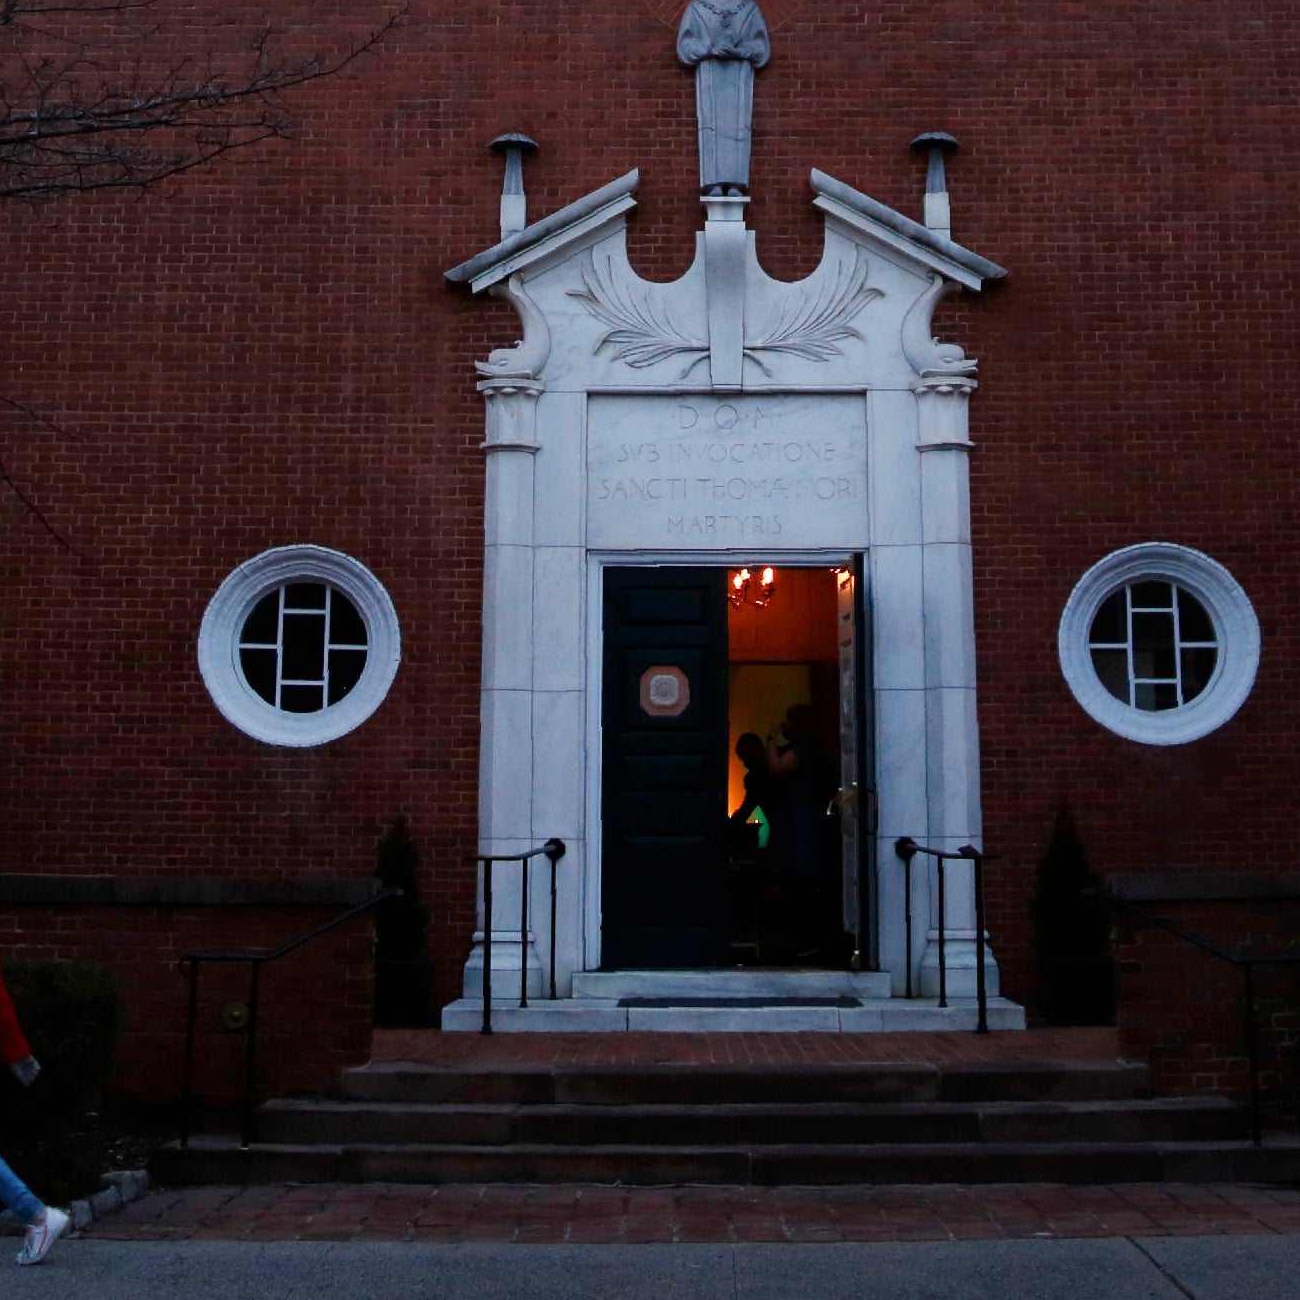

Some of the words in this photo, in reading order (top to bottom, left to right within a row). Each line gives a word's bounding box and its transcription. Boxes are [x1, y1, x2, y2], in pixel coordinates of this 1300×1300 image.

[616, 442, 661, 463] SVB
[670, 442, 837, 463] INVOCATIONE
[598, 477, 688, 500] SANCTI
[666, 514, 784, 535] MARTYRIS
